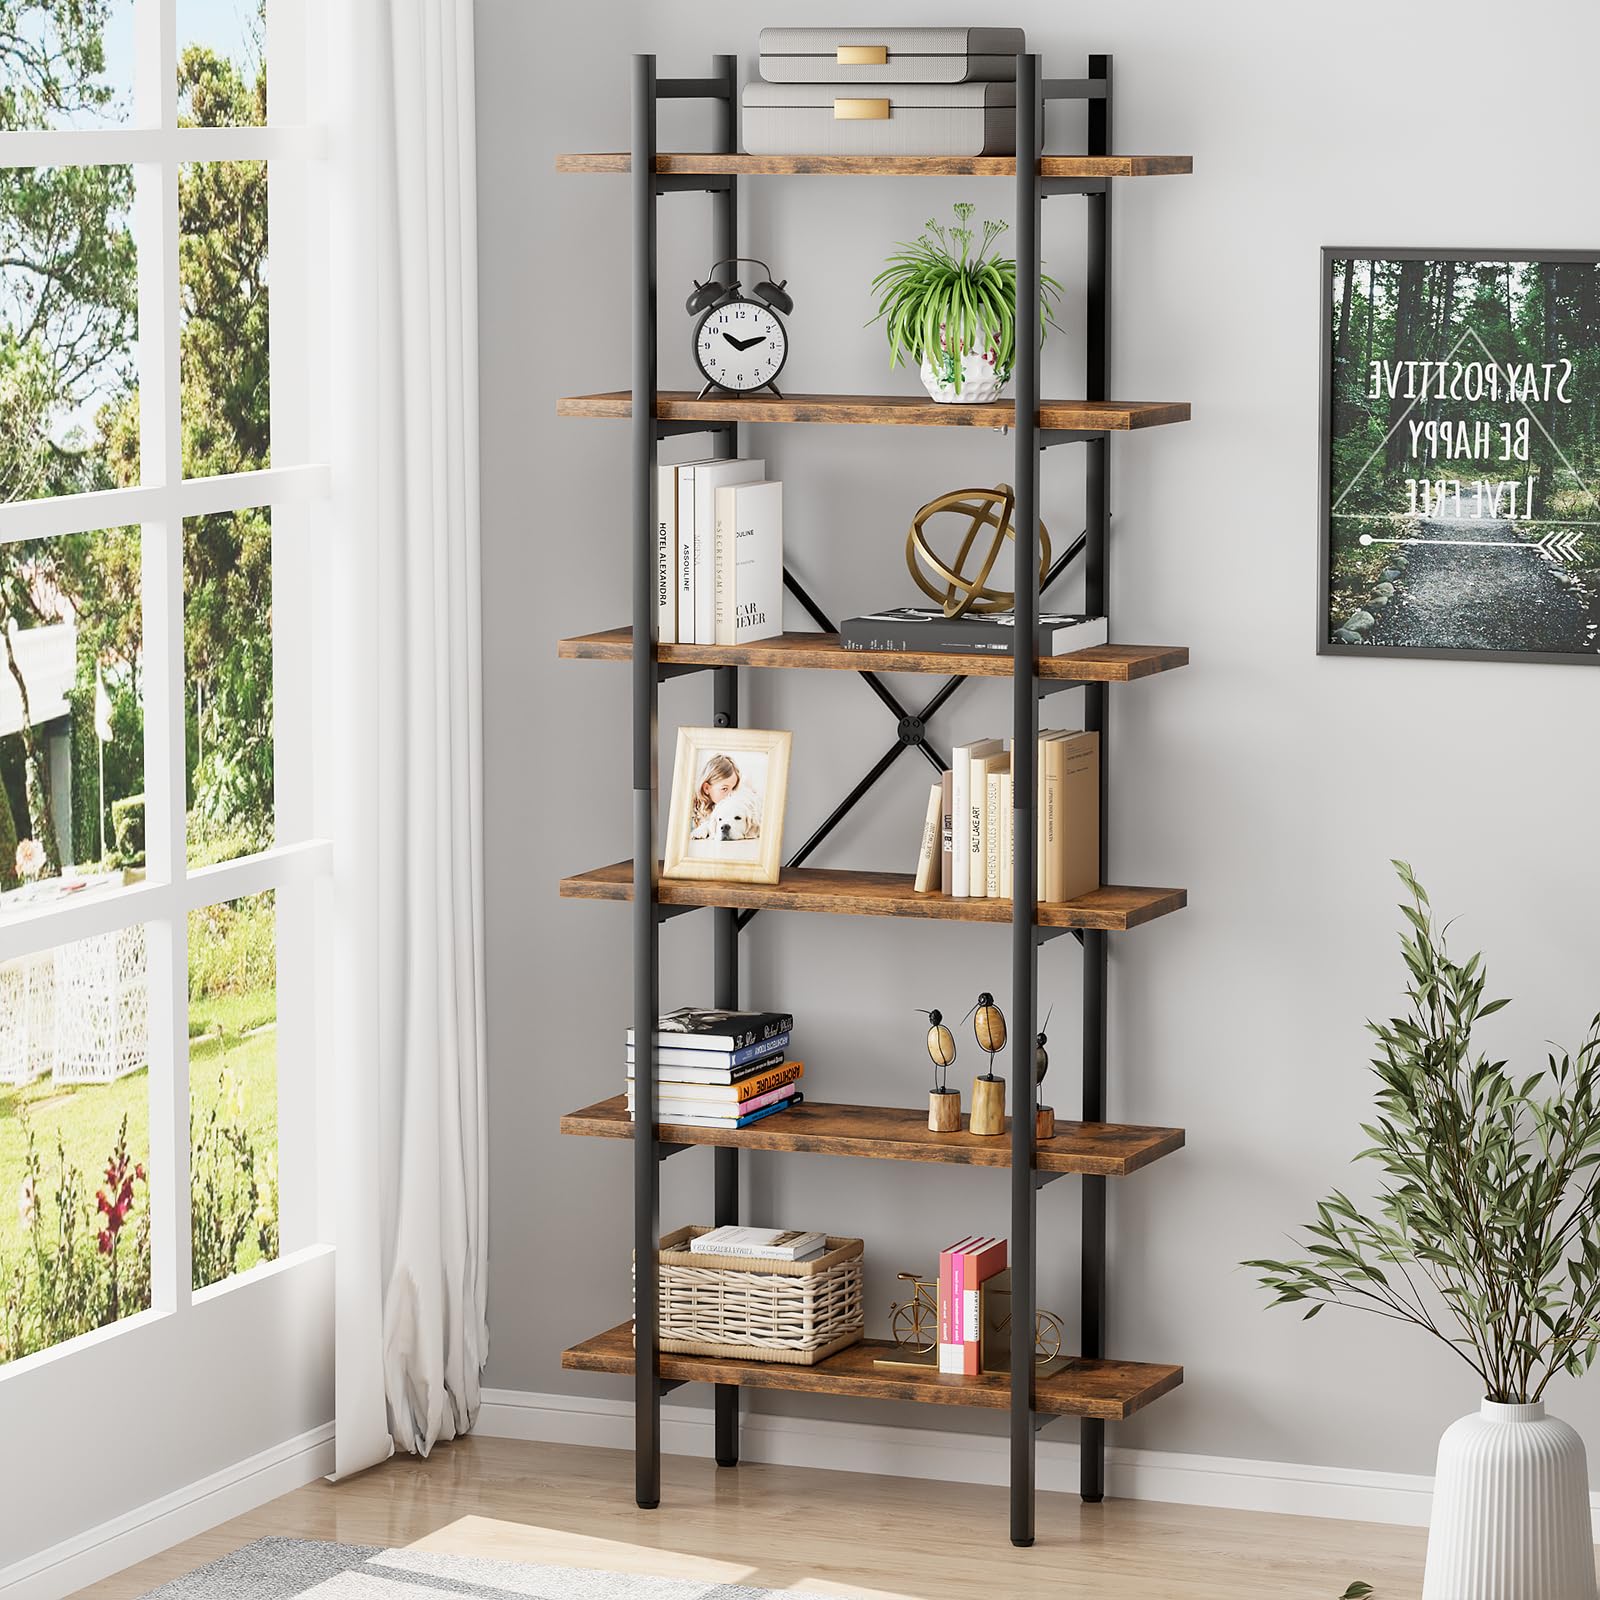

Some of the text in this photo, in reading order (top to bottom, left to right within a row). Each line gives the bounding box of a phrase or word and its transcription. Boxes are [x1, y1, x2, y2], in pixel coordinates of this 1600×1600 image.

[659, 522, 667, 607] HOTEL ALEXANDRA
[972, 806, 980, 853] SALT LAKE ART
[756, 1064, 801, 1093] ARCHITECTURE
